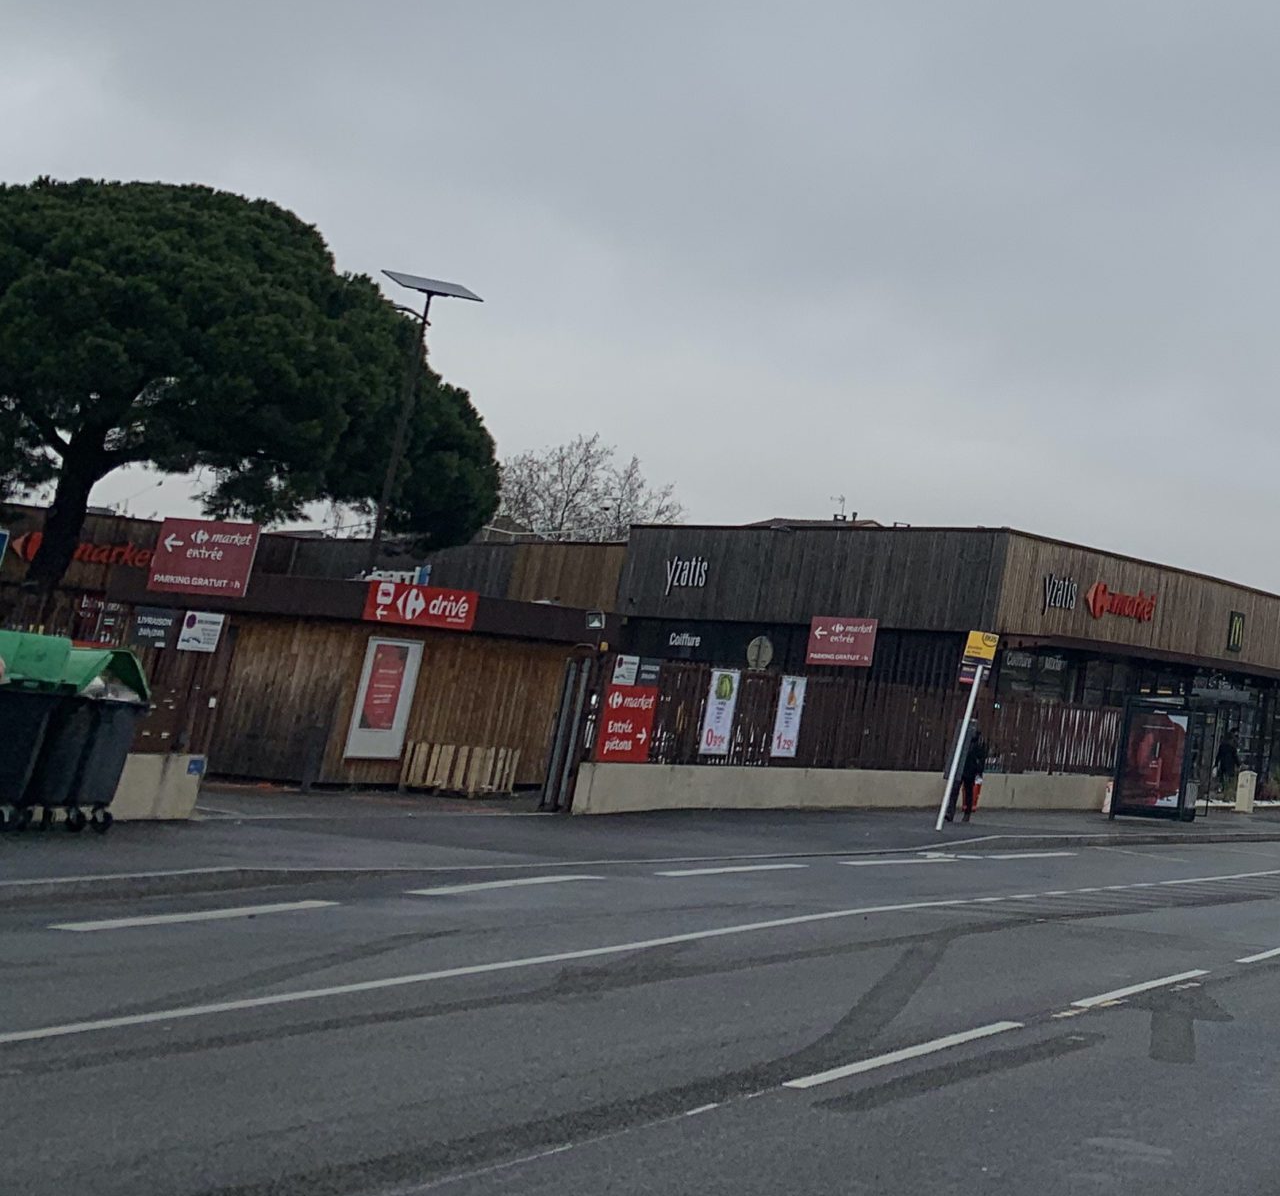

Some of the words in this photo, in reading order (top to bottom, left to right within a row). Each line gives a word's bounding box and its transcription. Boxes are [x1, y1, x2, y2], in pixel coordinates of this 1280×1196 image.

[211, 533, 252, 546] market
[74, 541, 151, 567] marke
[186, 546, 224, 560] entrée
[153, 574, 190, 585] PARKING
[191, 577, 227, 587] GRATUIT
[665, 555, 708, 596] yzatis
[1043, 573, 1078, 616] yzatis
[428, 595, 470, 618] drive
[669, 632, 701, 647] Coiffure
[623, 694, 655, 711] market
